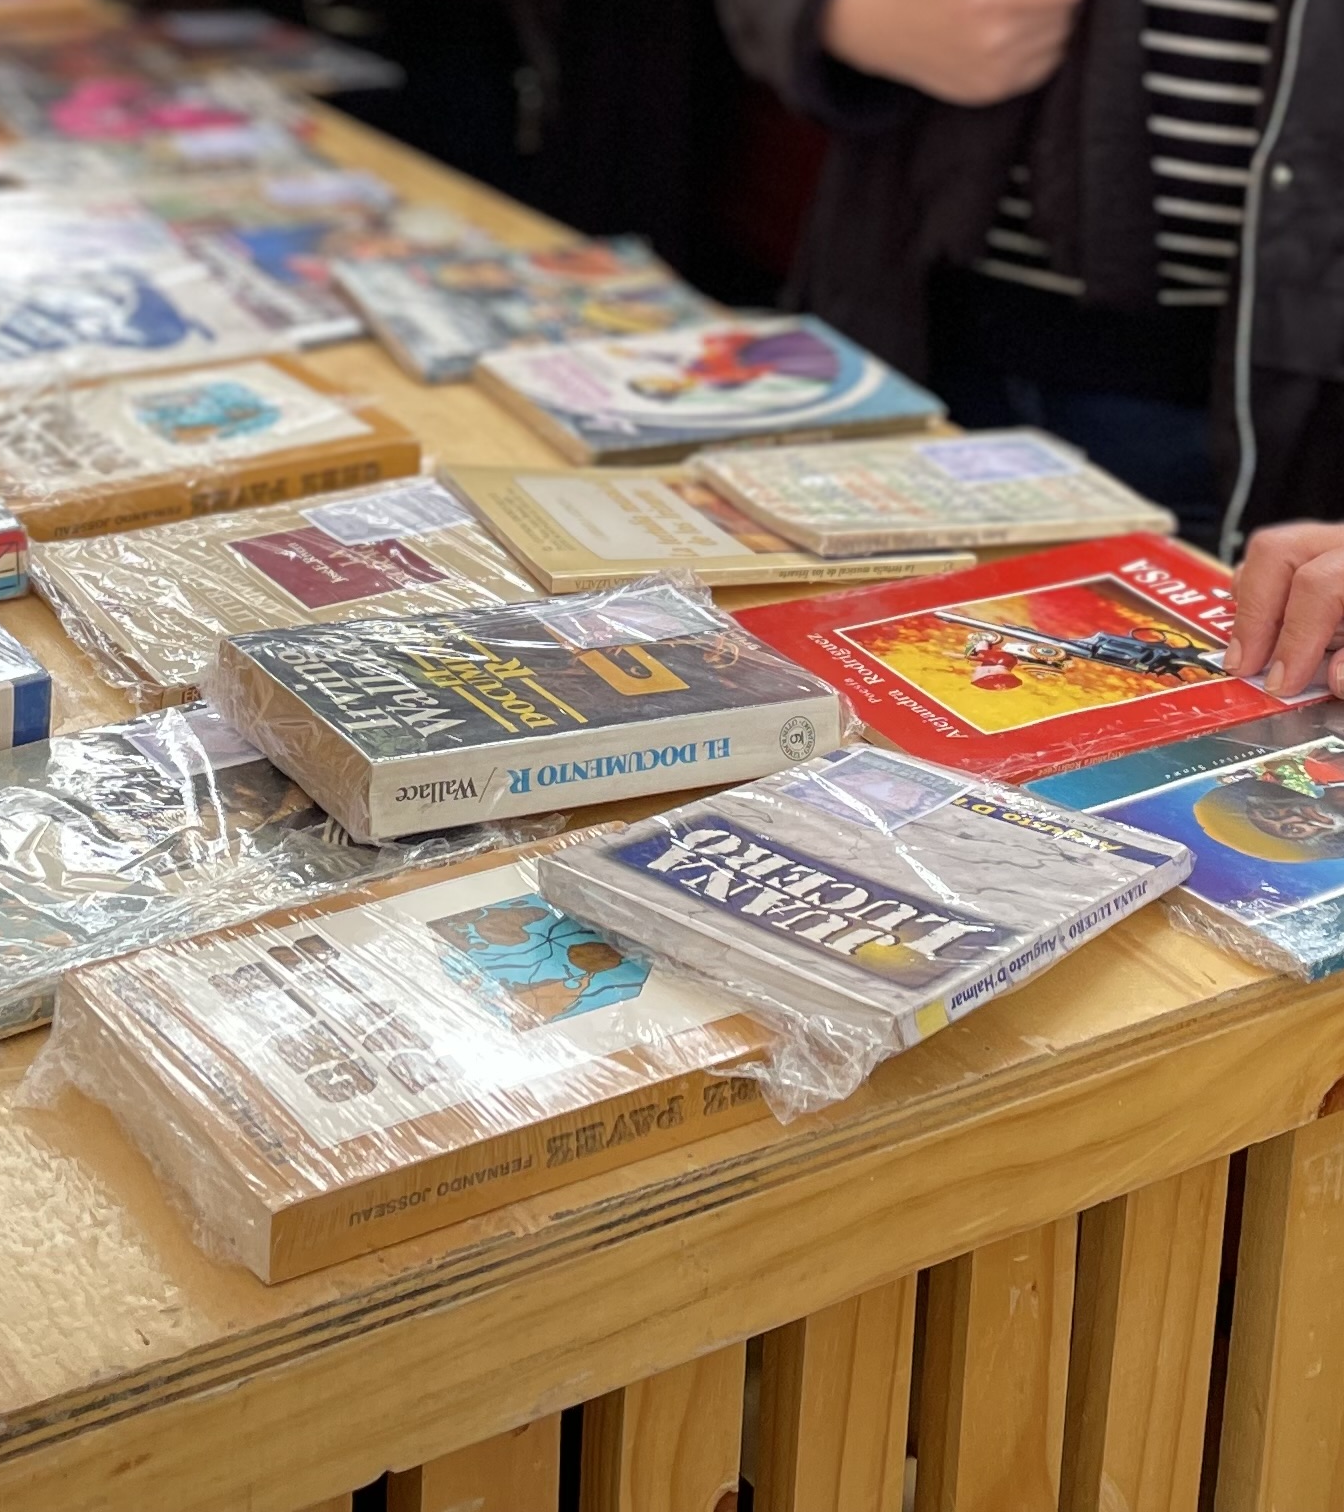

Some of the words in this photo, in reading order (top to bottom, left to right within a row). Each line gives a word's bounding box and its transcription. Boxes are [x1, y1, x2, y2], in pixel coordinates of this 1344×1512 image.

[1118, 556, 1206, 607] RUSA
[483, 657, 540, 680] R
[806, 632, 886, 687] Rodríguez
[277, 646, 403, 735] Irving
[888, 688, 969, 739] Alejandra
[537, 740, 698, 787] DOCUMENTO
[702, 737, 731, 761] EL
[396, 774, 480, 805] Wallace
[508, 768, 531, 796] R
[647, 847, 906, 956] JUANA
[683, 826, 997, 959] LUCERO
[1113, 879, 1149, 911] JUANA
[1068, 905, 1113, 940] LUCERO
[1008, 934, 1057, 974] Augusto
[950, 964, 1007, 1011] D'Halmar
[545, 1093, 686, 1169] PAVEZ
[435, 1156, 533, 1200] FERNANDO
[350, 1189, 431, 1226] JOSSEAU
